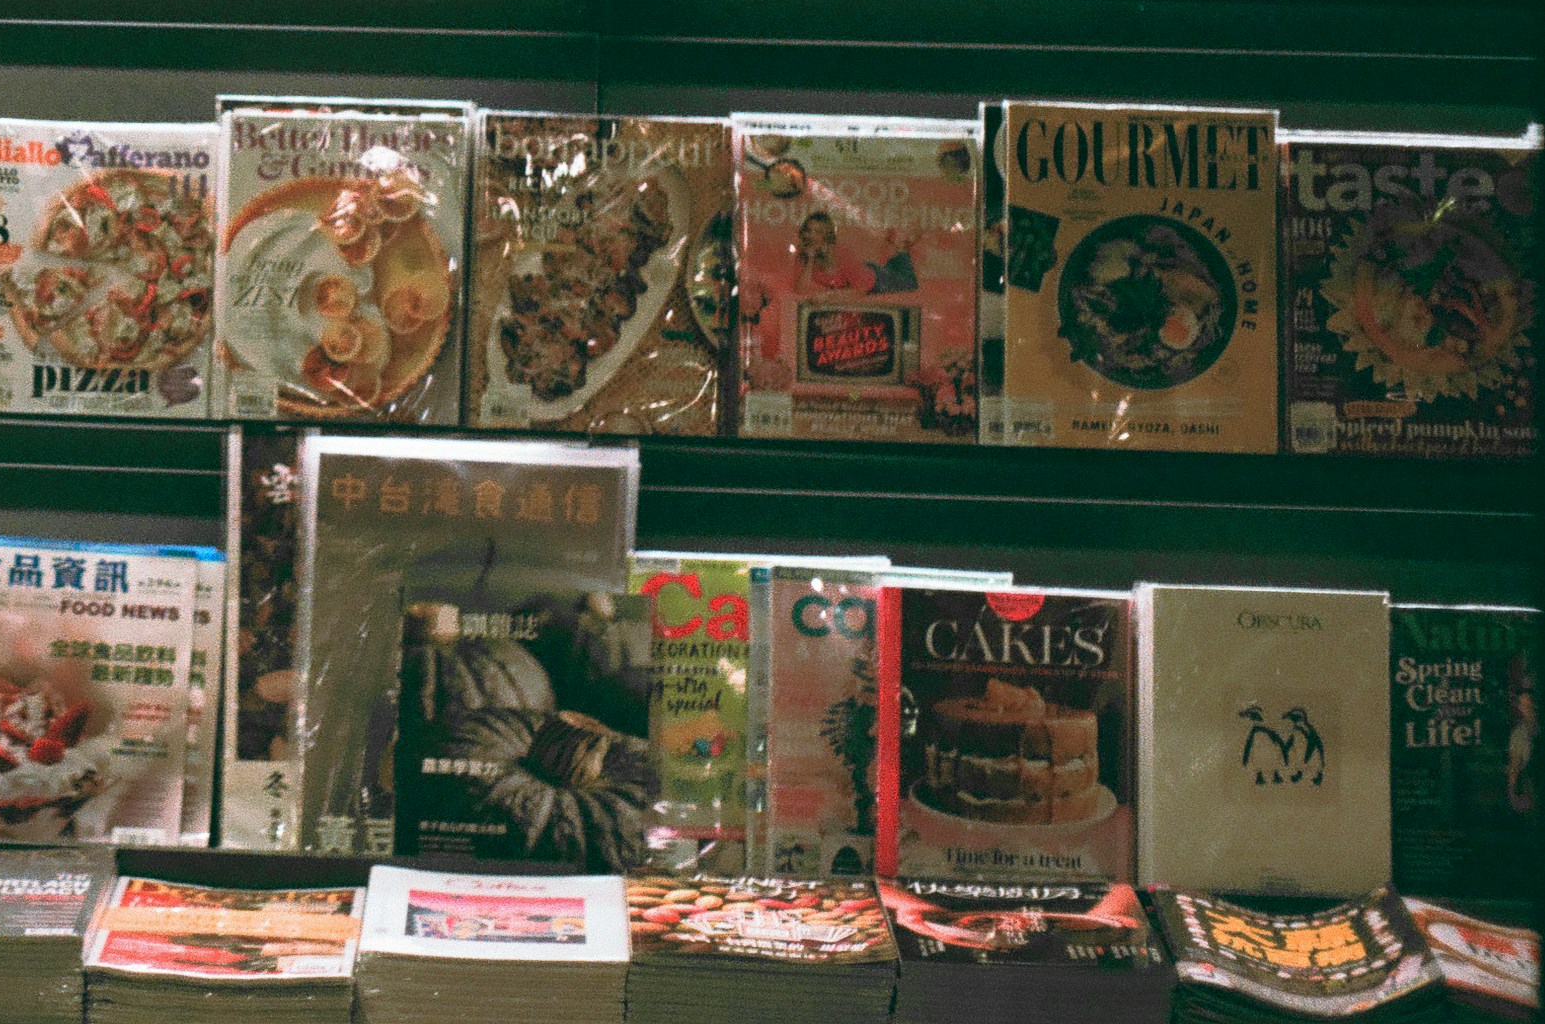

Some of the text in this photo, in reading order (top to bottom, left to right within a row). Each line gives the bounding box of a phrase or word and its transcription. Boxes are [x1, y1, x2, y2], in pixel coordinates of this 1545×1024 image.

[1016, 119, 1268, 191] GOURMET
[1293, 148, 1495, 212] taste
[1158, 197, 1232, 244] JAPAN
[1235, 260, 1257, 331] HOME
[813, 324, 884, 352] BEAUTY
[816, 338, 889, 367] AWARDS
[33, 364, 149, 397] pizza
[1407, 420, 1497, 442] pumpkin
[331, 473, 603, 523] 中台灣食通信
[59, 600, 180, 621] FOOD NEWS
[926, 619, 1107, 666] CAKES
[1394, 656, 1484, 686] Spring
[1406, 681, 1485, 712] Clean
[1405, 720, 1483, 749] Life!
